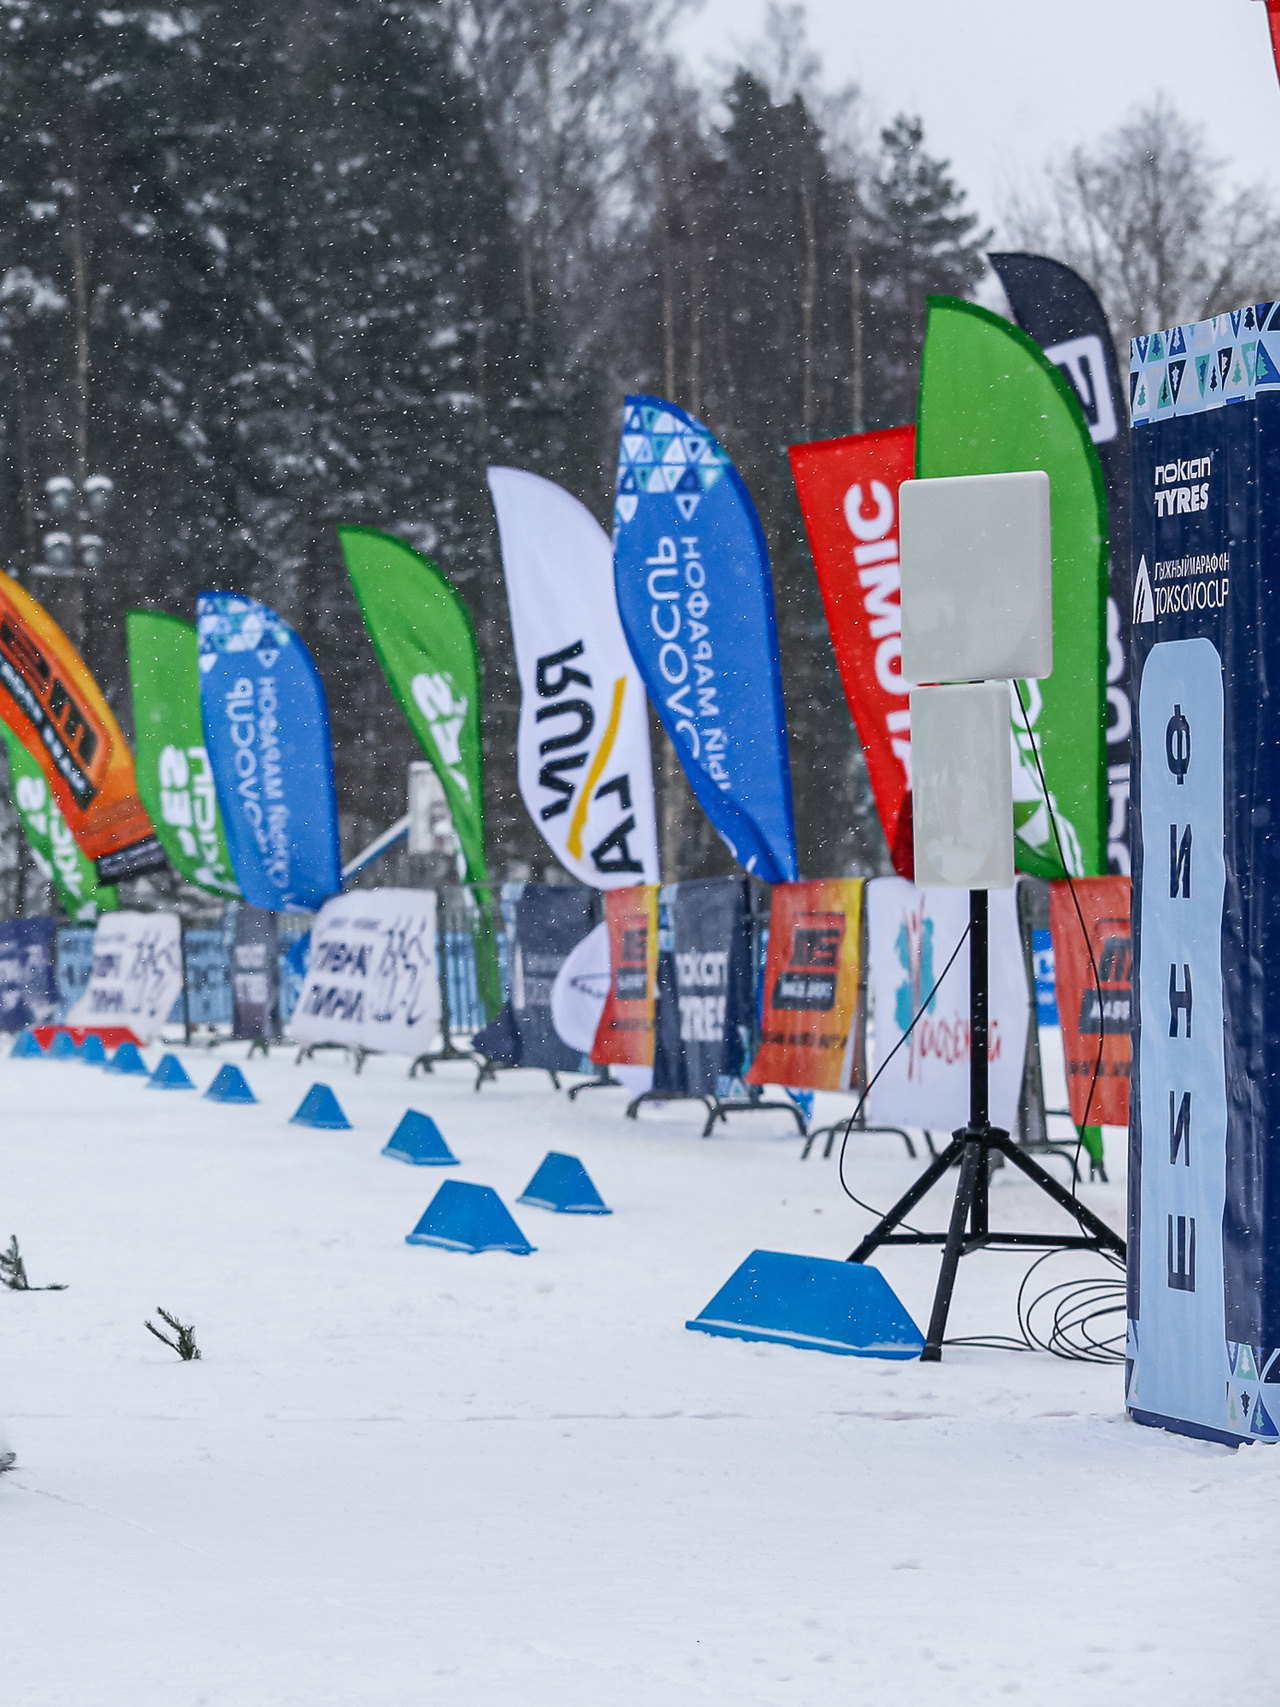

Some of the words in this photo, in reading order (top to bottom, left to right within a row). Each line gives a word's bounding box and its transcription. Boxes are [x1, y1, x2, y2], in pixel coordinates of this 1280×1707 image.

[1154, 457, 1210, 485] nokian
[1154, 483, 1209, 517] TYRES
[1166, 703, 1196, 1293] ФИНИШ
